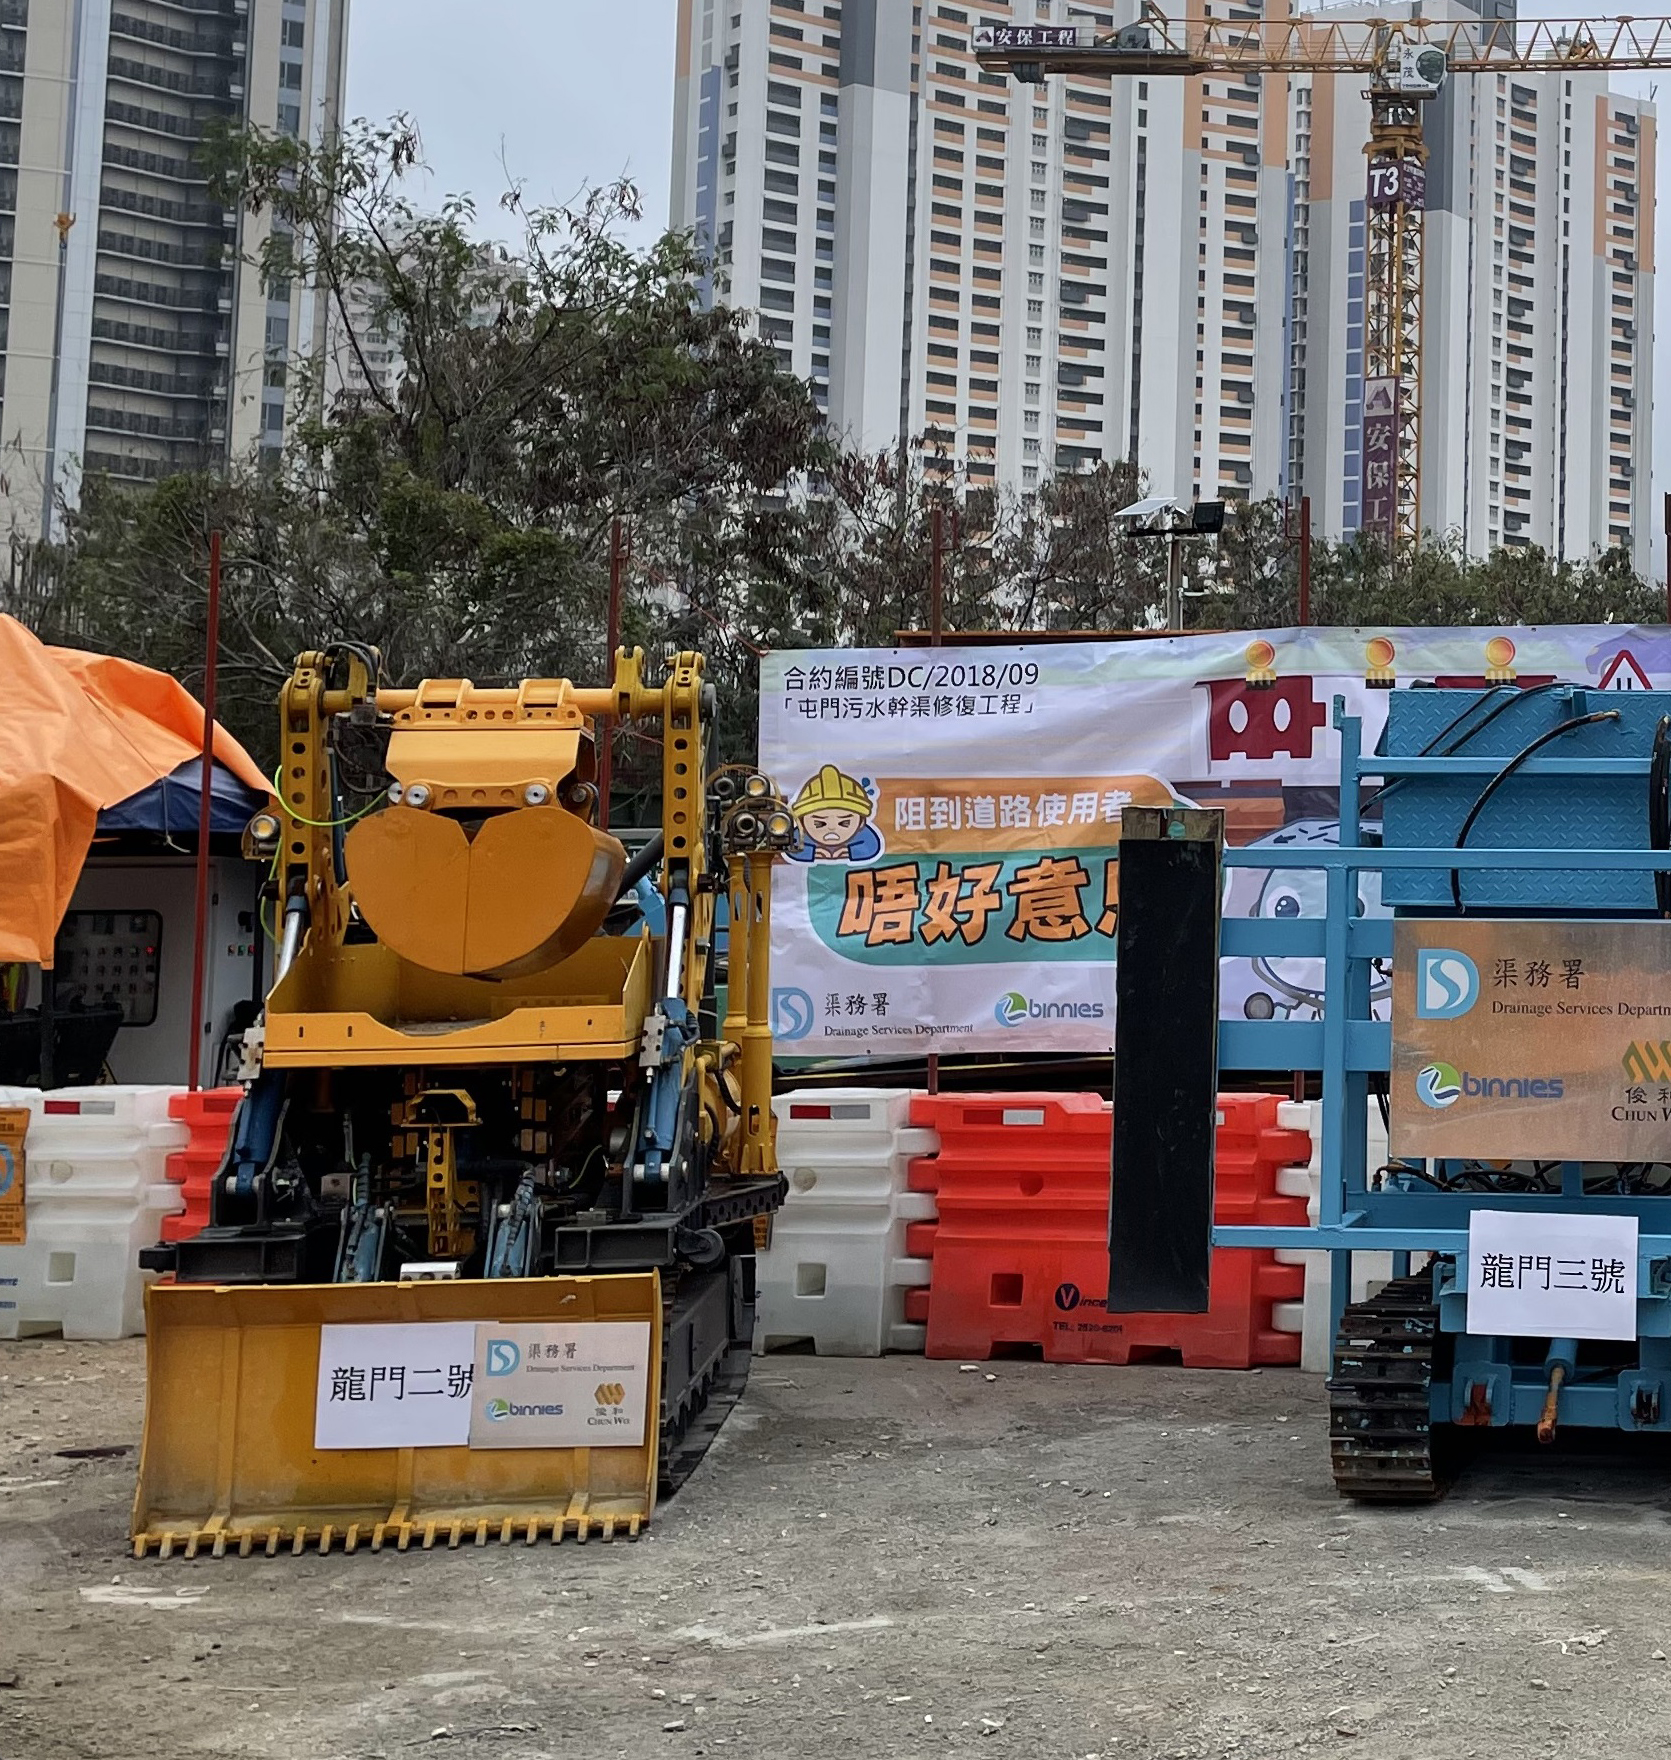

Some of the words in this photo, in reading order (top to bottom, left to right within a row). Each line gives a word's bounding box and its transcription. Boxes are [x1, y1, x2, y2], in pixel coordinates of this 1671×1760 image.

[995, 28, 1075, 46] 安保工程
[1369, 166, 1400, 198] T3
[784, 662, 1039, 691] 合約編號DC/2018/09
[784, 693, 1034, 719] 「屯門污水幹渠修復工程」
[894, 789, 1133, 832] 阻到道路使用者
[1492, 957, 1586, 990] 渠務署
[824, 992, 890, 1017] 渠務署
[1028, 998, 1105, 1019] binnies
[1492, 1001, 1551, 1017] Drainage
[1557, 1001, 1613, 1016] Services
[824, 1025, 869, 1038] Drainage
[871, 1024, 913, 1036] Services
[915, 1023, 974, 1036] Department
[1462, 1071, 1565, 1099] binnies
[1480, 1252, 1626, 1294] 龍門三號
[330, 1362, 475, 1402] 龍門二號
[509, 1402, 564, 1417] binnies
